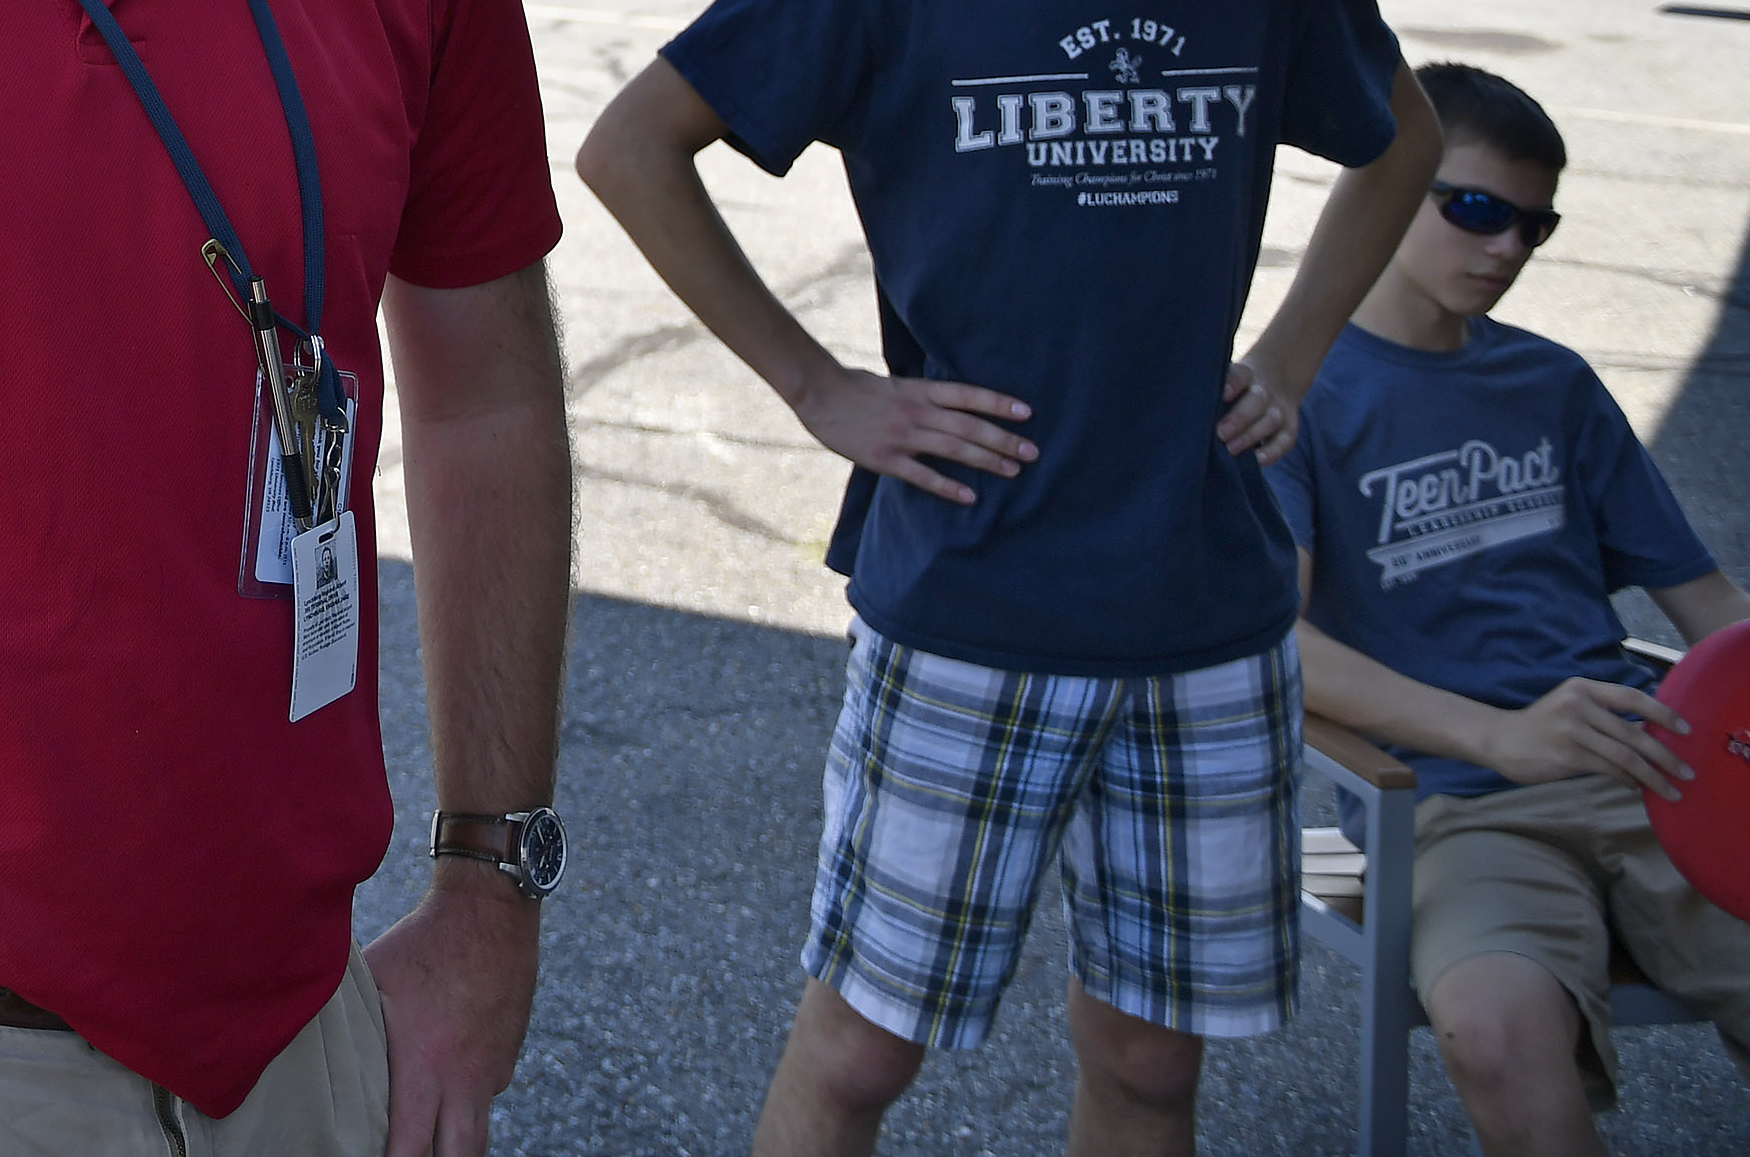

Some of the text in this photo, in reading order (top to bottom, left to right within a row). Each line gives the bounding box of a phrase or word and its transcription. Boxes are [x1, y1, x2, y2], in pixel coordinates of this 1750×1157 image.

[1058, 16, 1187, 61] EST. 1971
[951, 84, 1257, 154] LIBERTY
[1025, 136, 1220, 168] UNIVERSITY
[1076, 190, 1180, 208] #LUCHAMPIONS
